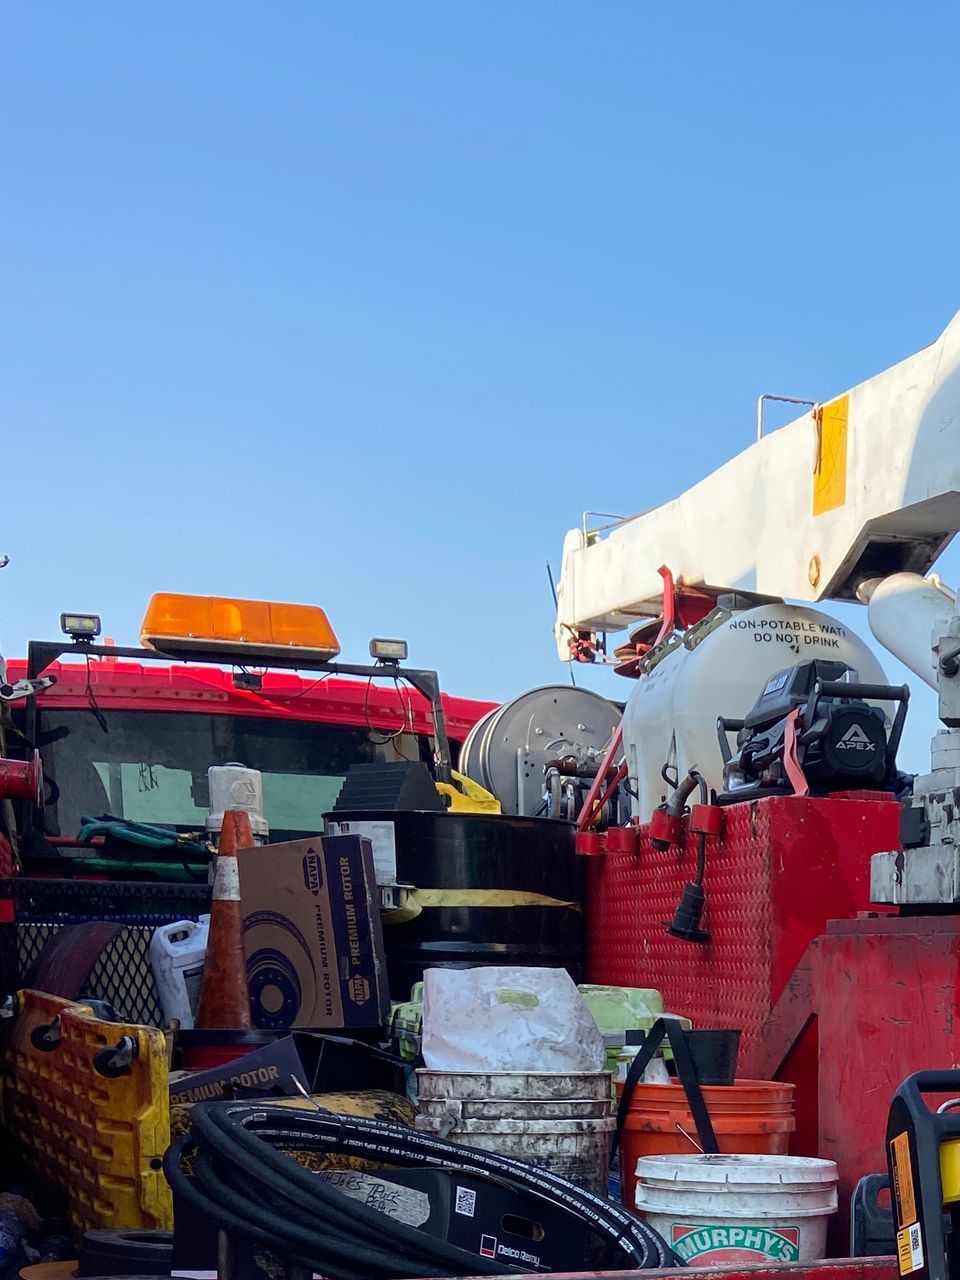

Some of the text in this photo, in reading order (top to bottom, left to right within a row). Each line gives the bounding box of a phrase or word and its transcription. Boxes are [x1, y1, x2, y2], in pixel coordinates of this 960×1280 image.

[729, 620, 816, 632] NON-POTABLE
[754, 633, 840, 648] DO NOT DRINK
[835, 740, 876, 751] APEX
[307, 854, 333, 1017] NAPA PREMIUM ROTOR
[339, 856, 369, 1002] NAPA PREMIUM ROTOR
[170, 1081, 226, 1105] REMIUM
[497, 1244, 541, 1267] Delco Remy
[676, 1228, 794, 1262] MURPHY'S
